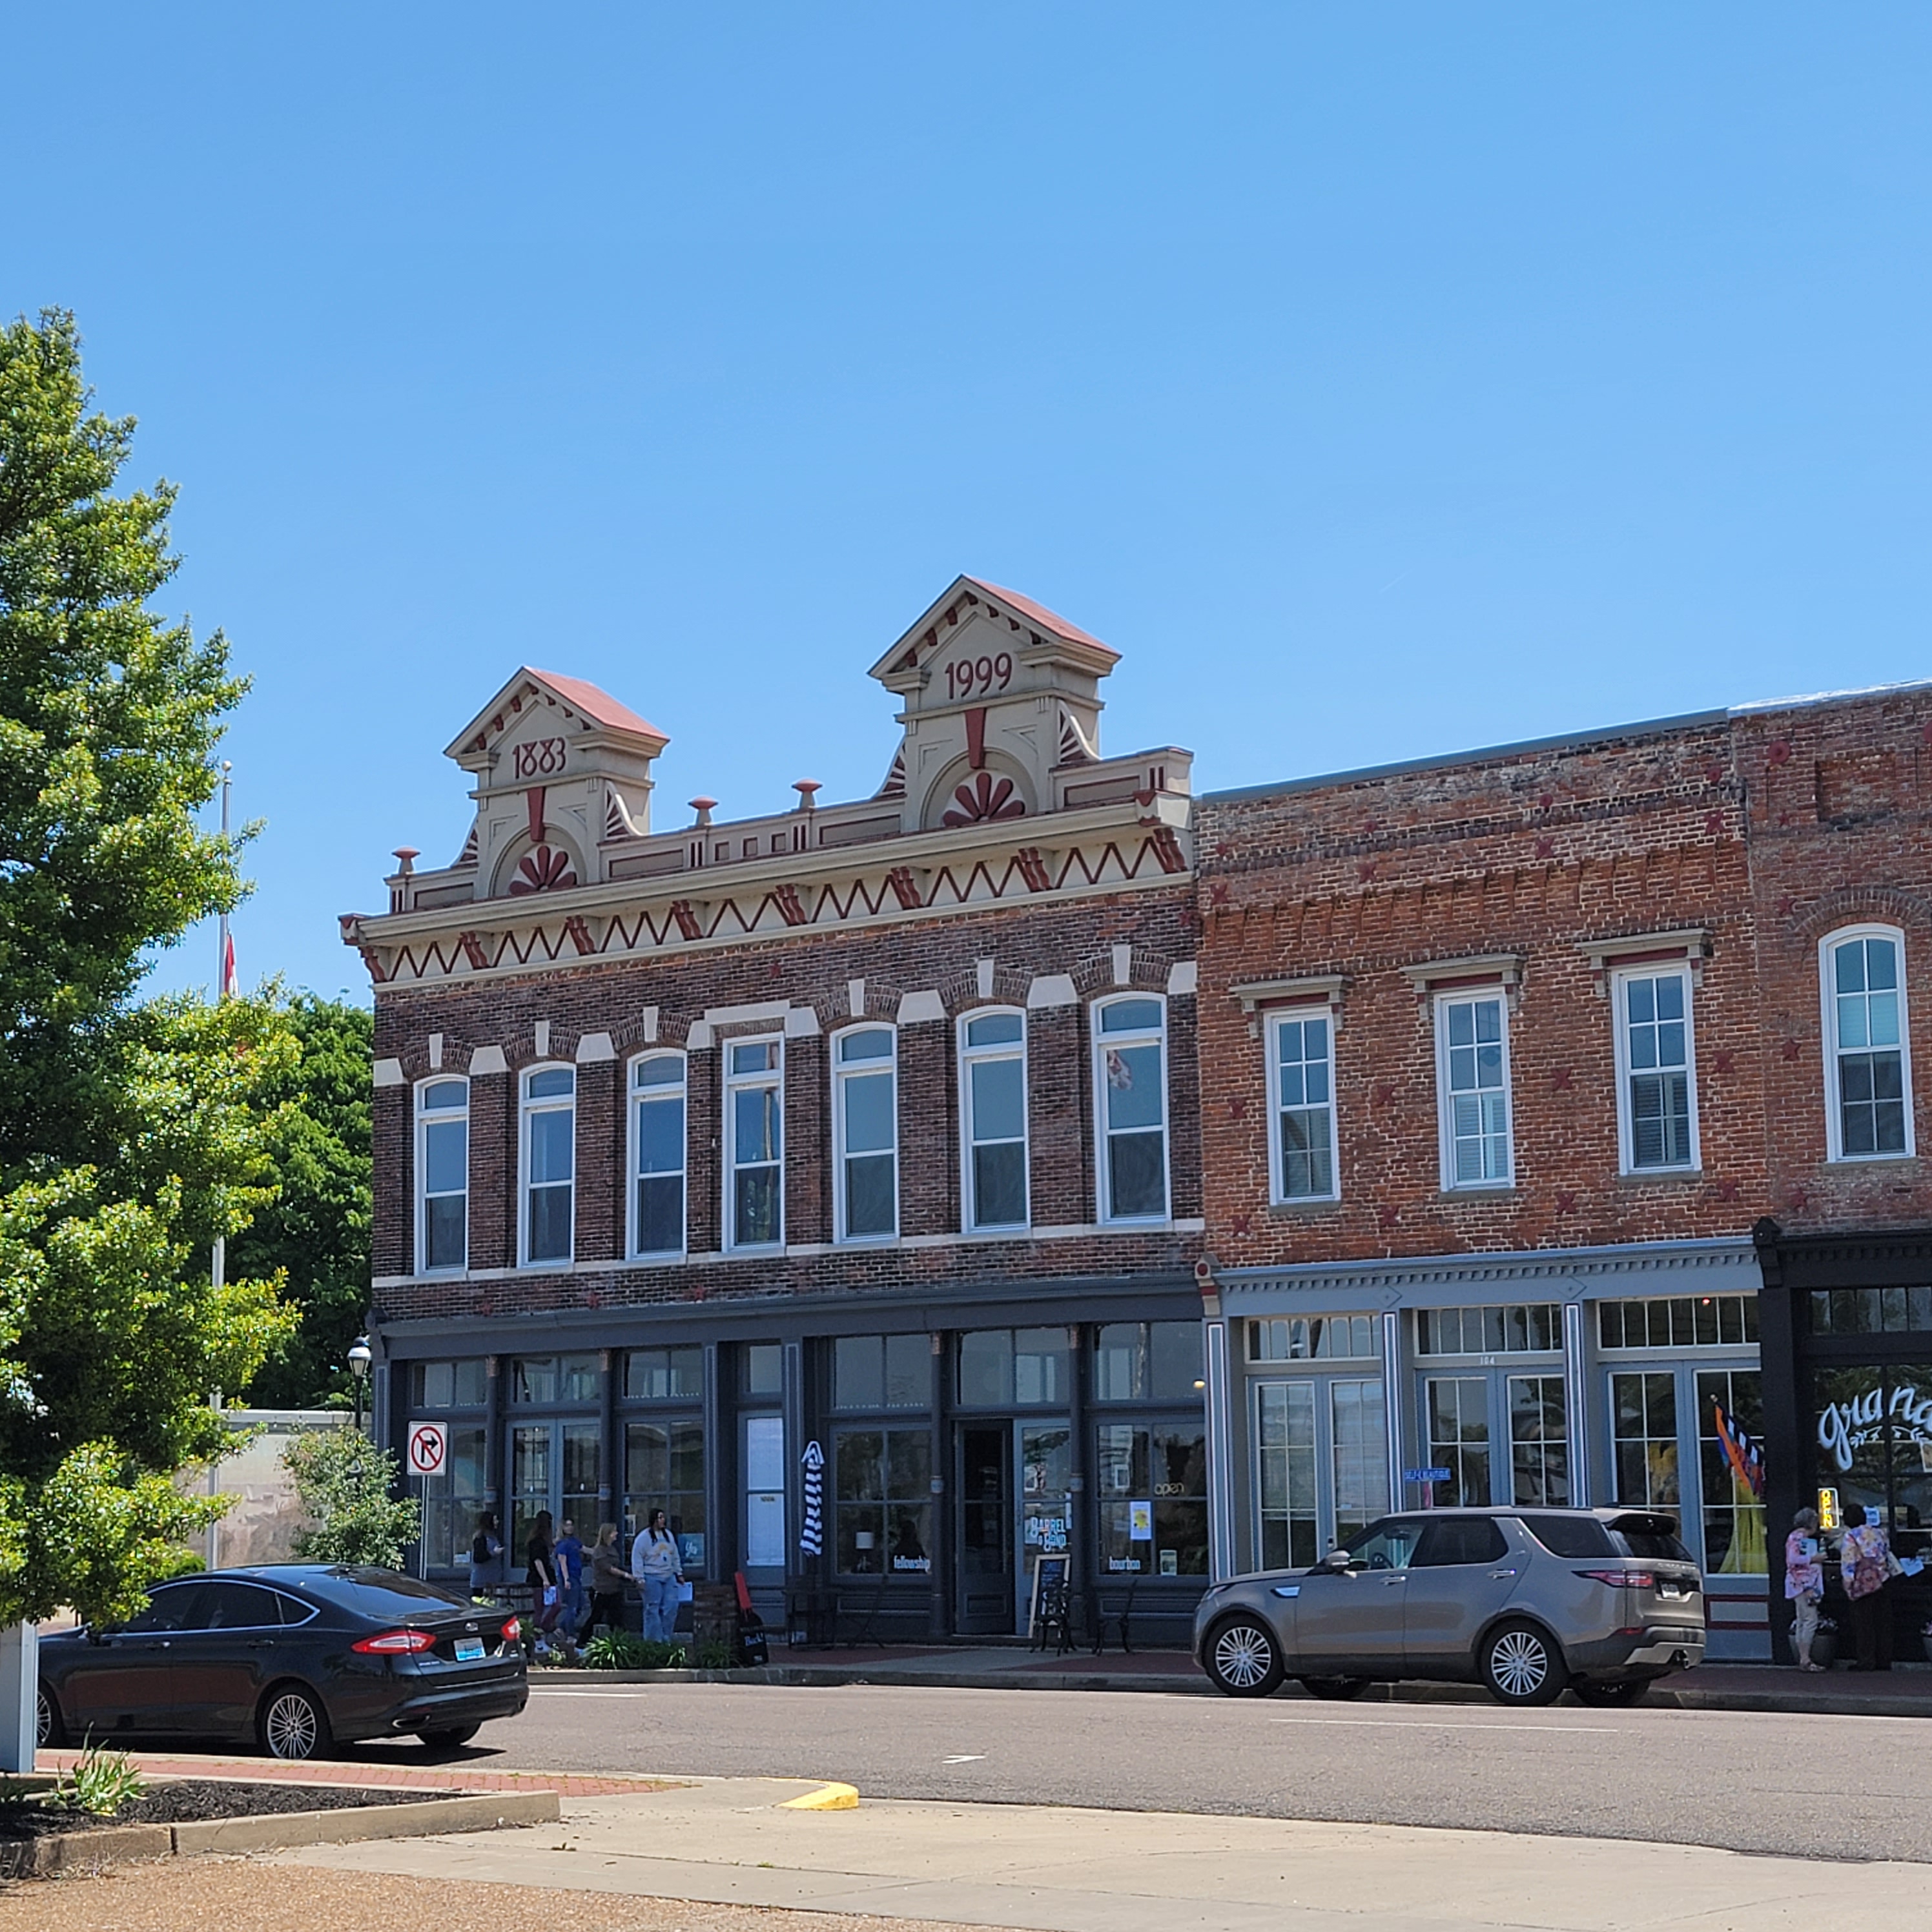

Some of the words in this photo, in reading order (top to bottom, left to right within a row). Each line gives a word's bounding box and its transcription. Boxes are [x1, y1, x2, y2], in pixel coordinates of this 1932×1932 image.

[945, 652, 1012, 699] 1999
[512, 737, 566, 779] 1883
[1481, 1356, 1495, 1364] 104
[1155, 1483, 1184, 1497] open
[1031, 1517, 1065, 1537] BARREL
[894, 1555, 930, 1573] fellowship
[1109, 1556, 1140, 1570] bourbon
